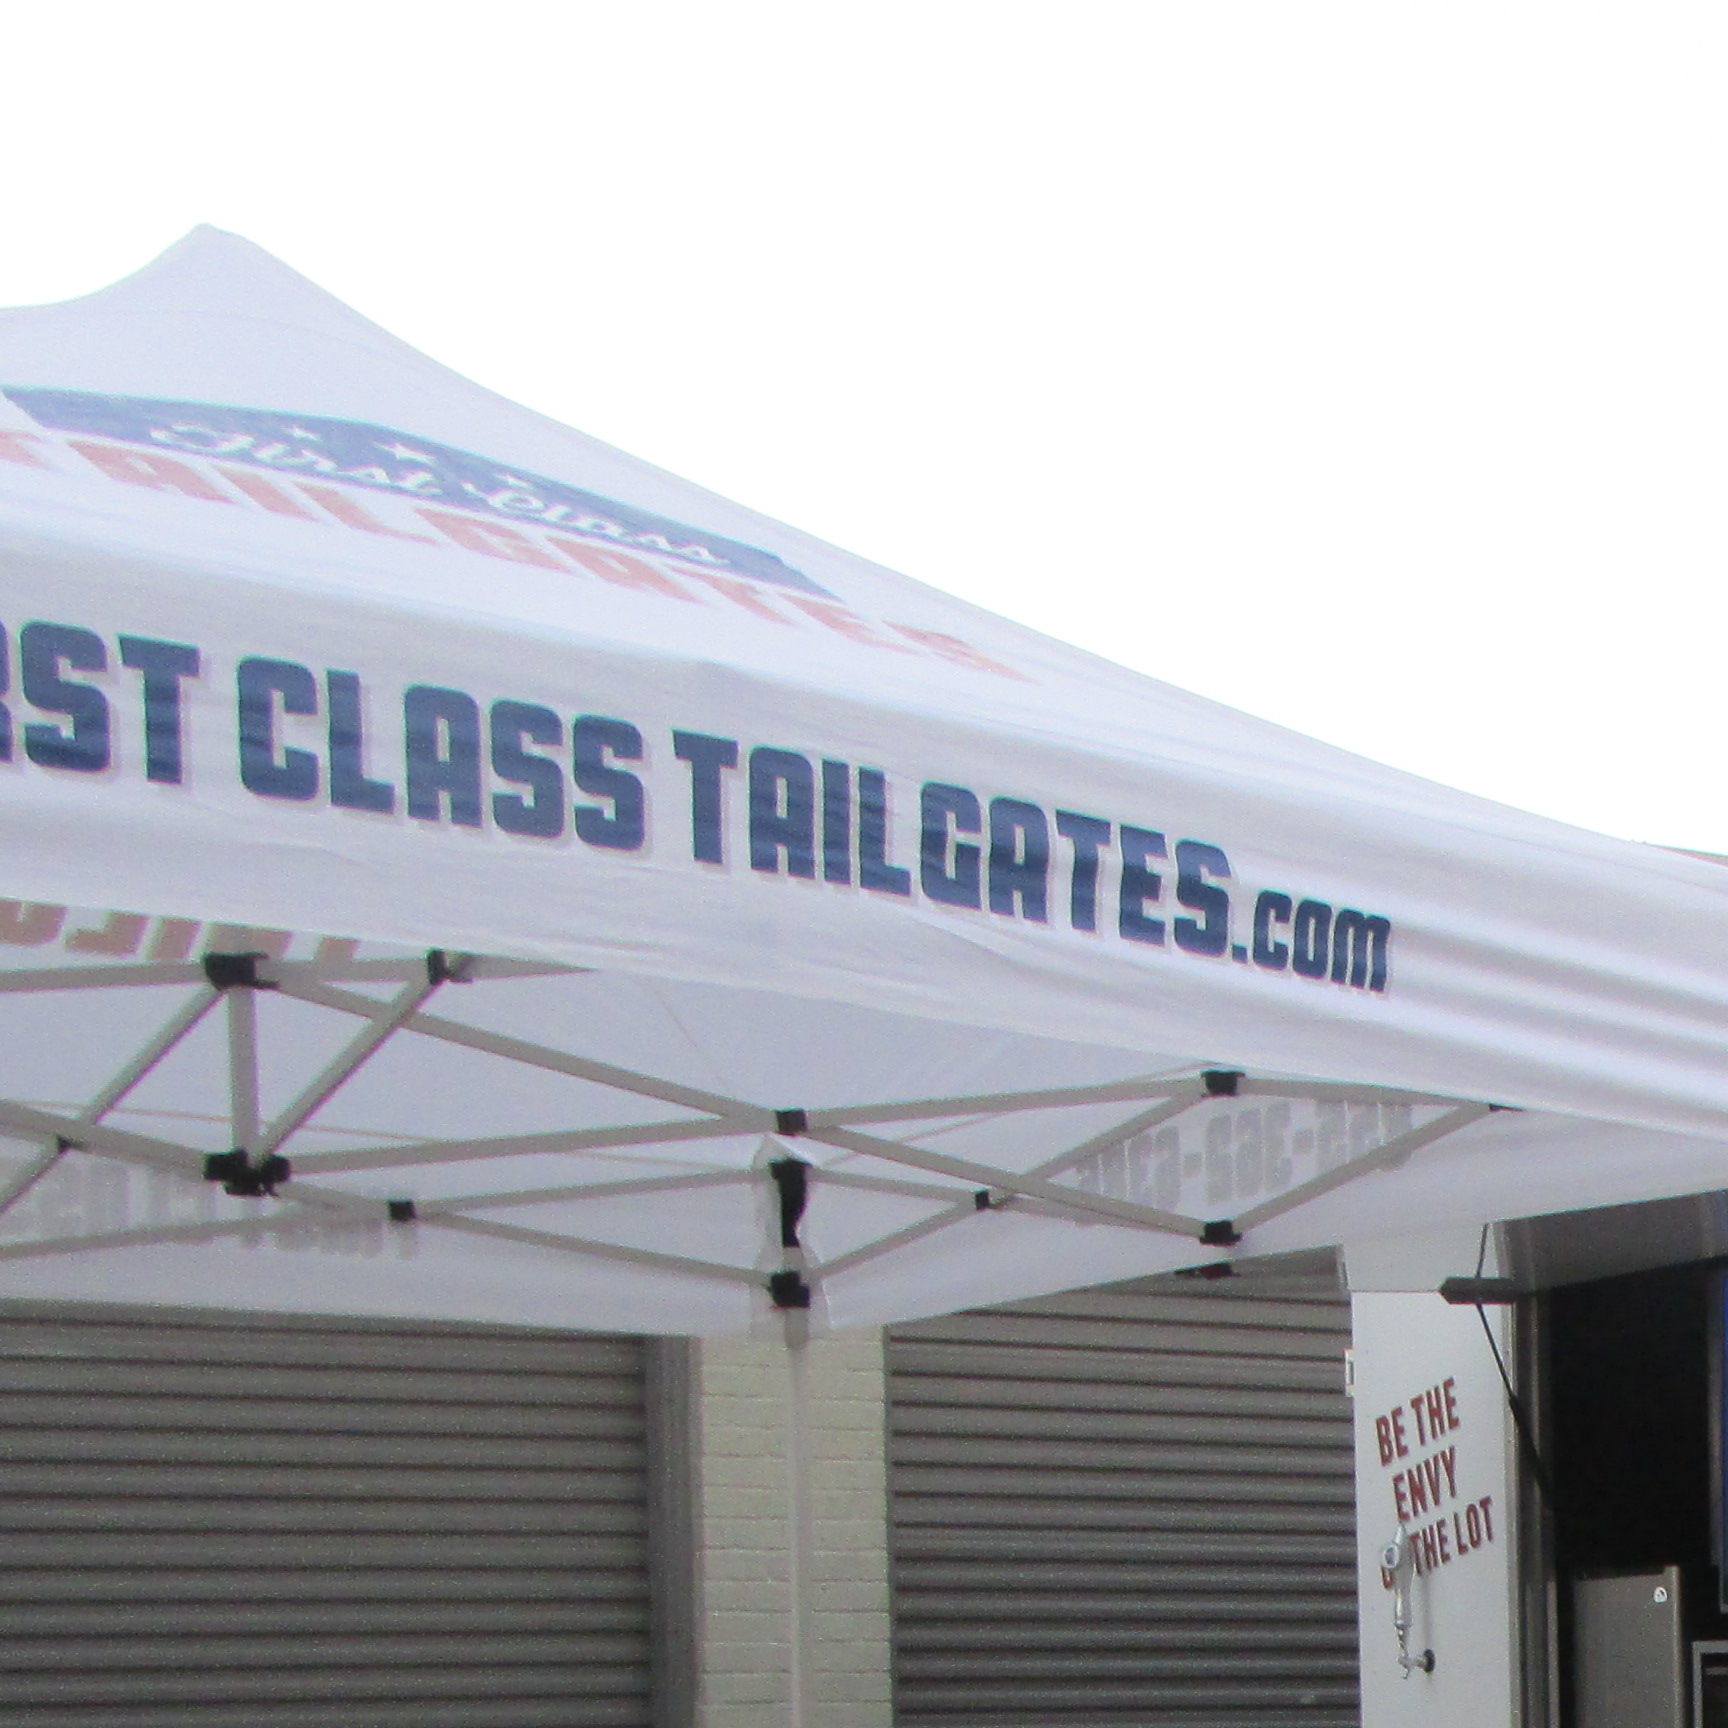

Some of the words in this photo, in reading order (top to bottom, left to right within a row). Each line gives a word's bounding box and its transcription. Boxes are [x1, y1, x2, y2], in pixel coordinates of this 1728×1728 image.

[0, 618, 202, 785] ST
[236, 655, 646, 852] CLASS
[1375, 1406, 1408, 1467] BE
[1410, 1377, 1460, 1447] THE
[1392, 1446, 1457, 1522] ENVY
[1409, 1518, 1451, 1577] THE
[1453, 1496, 1493, 1555] LOT
